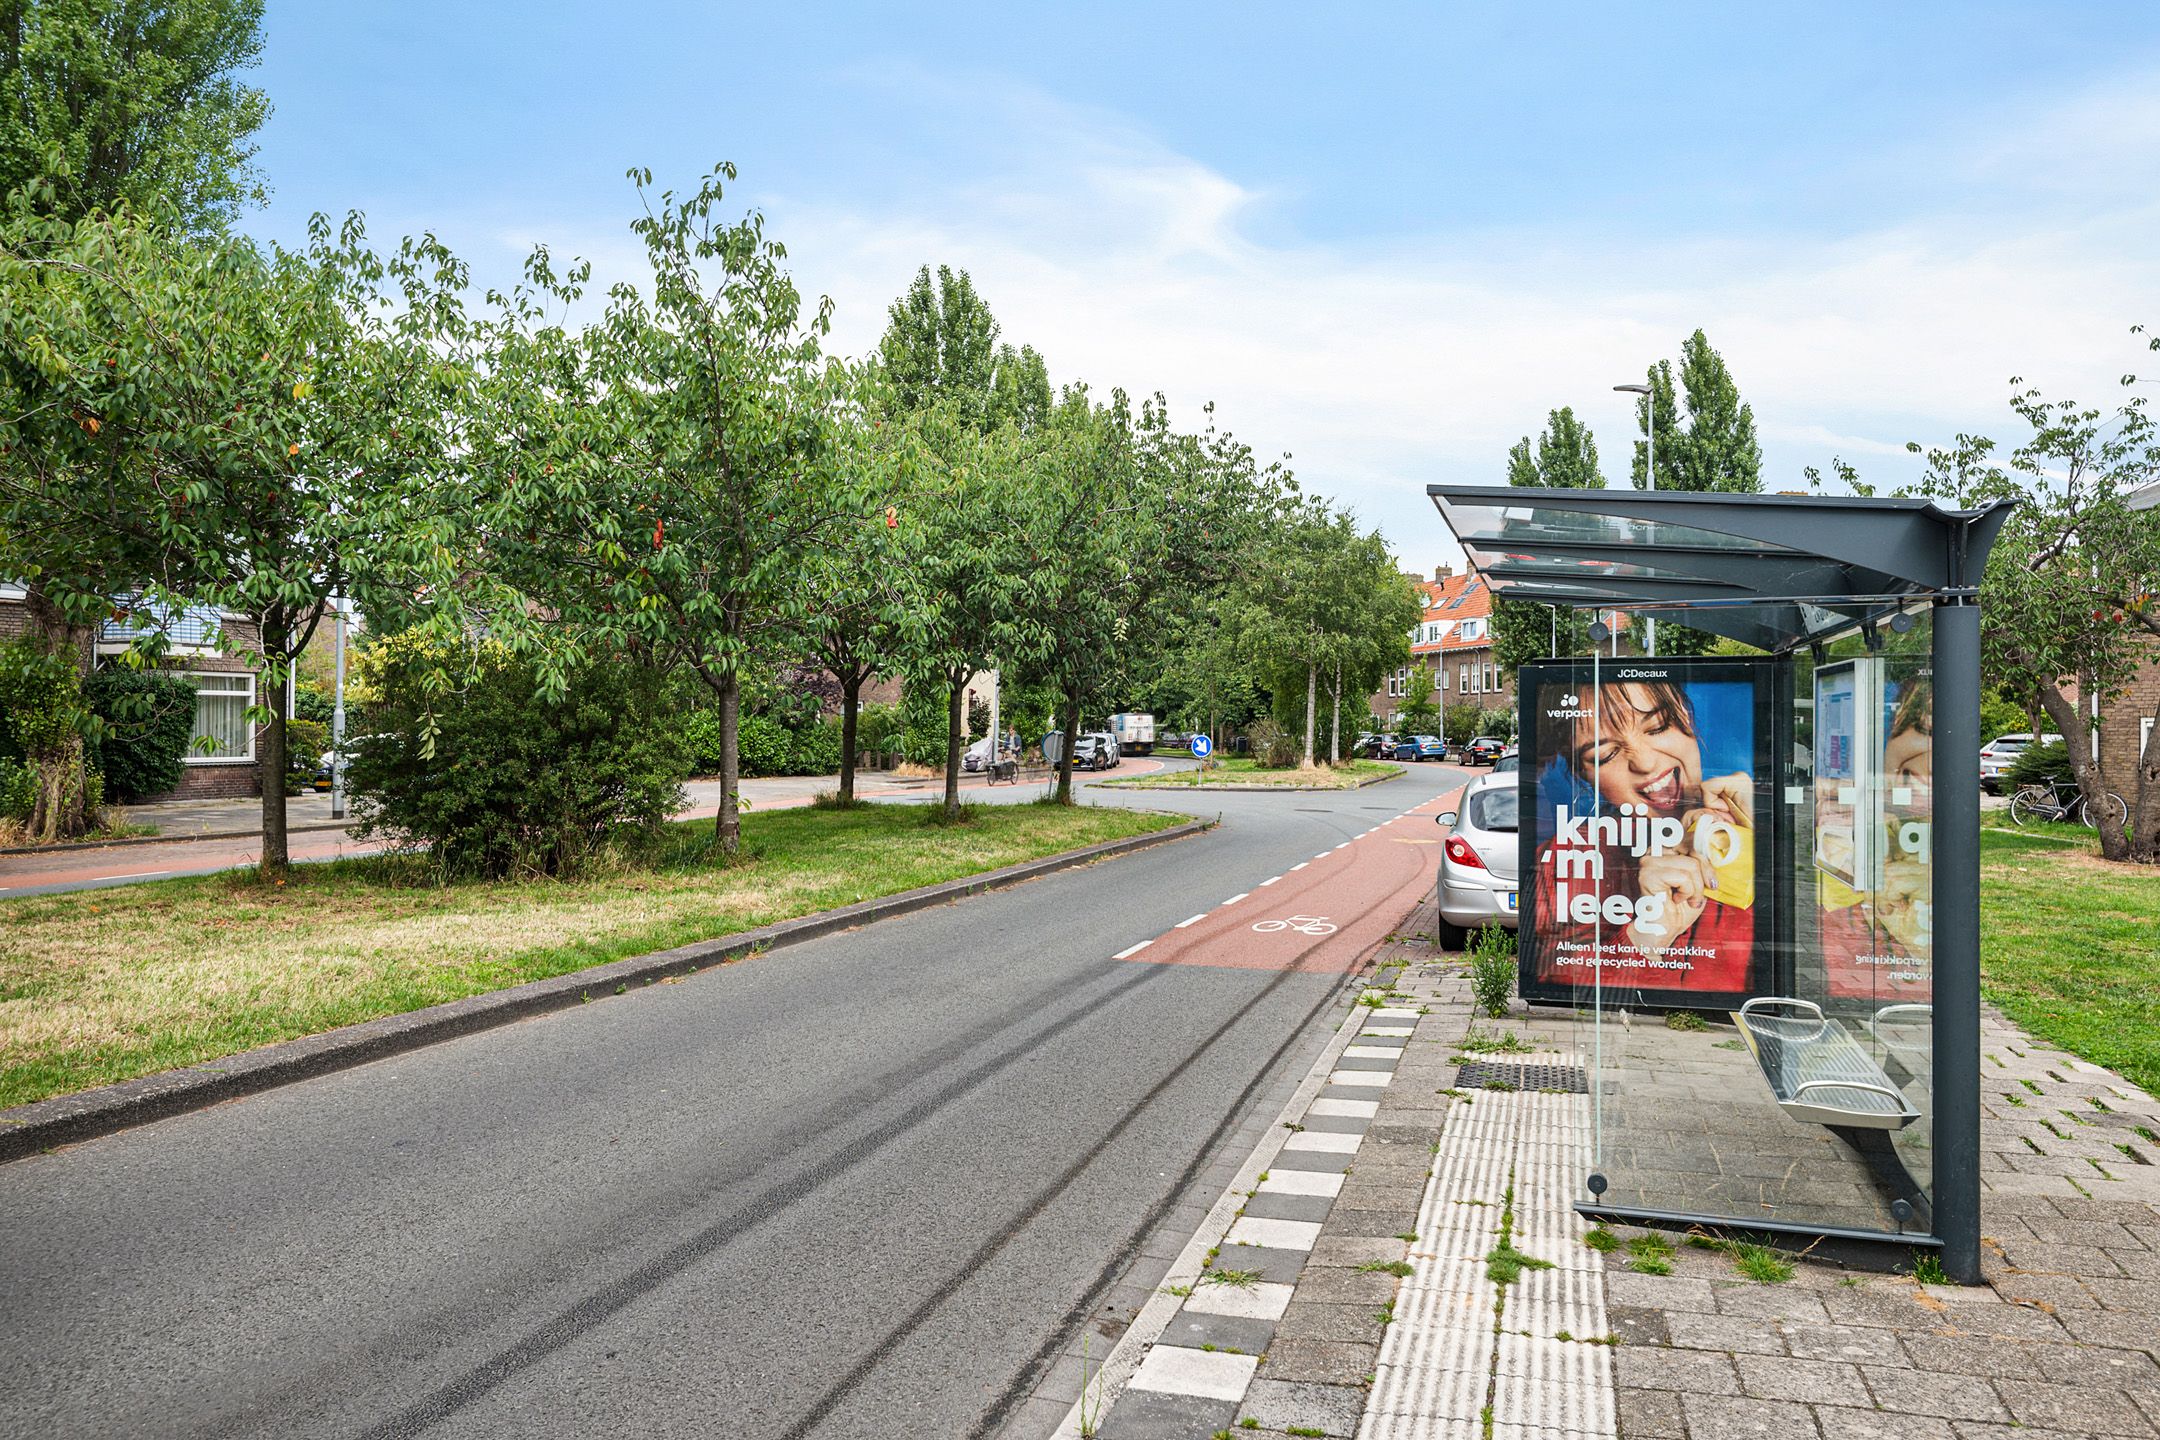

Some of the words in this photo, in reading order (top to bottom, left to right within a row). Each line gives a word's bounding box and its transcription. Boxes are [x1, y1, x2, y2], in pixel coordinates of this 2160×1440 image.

[1617, 668, 1668, 678] JCDecaux
[1546, 708, 1594, 720] verpact
[1556, 802, 1685, 858] knijp
[1556, 881, 1668, 937] leeg
[1556, 941, 1591, 952] Alleen
[1617, 943, 1638, 954] kan
[1639, 944, 1650, 956] je
[1652, 945, 1716, 959] verpakking
[1556, 955, 1584, 967] goed
[1585, 957, 1646, 969] gerecycled
[1648, 959, 1694, 970] worden.
